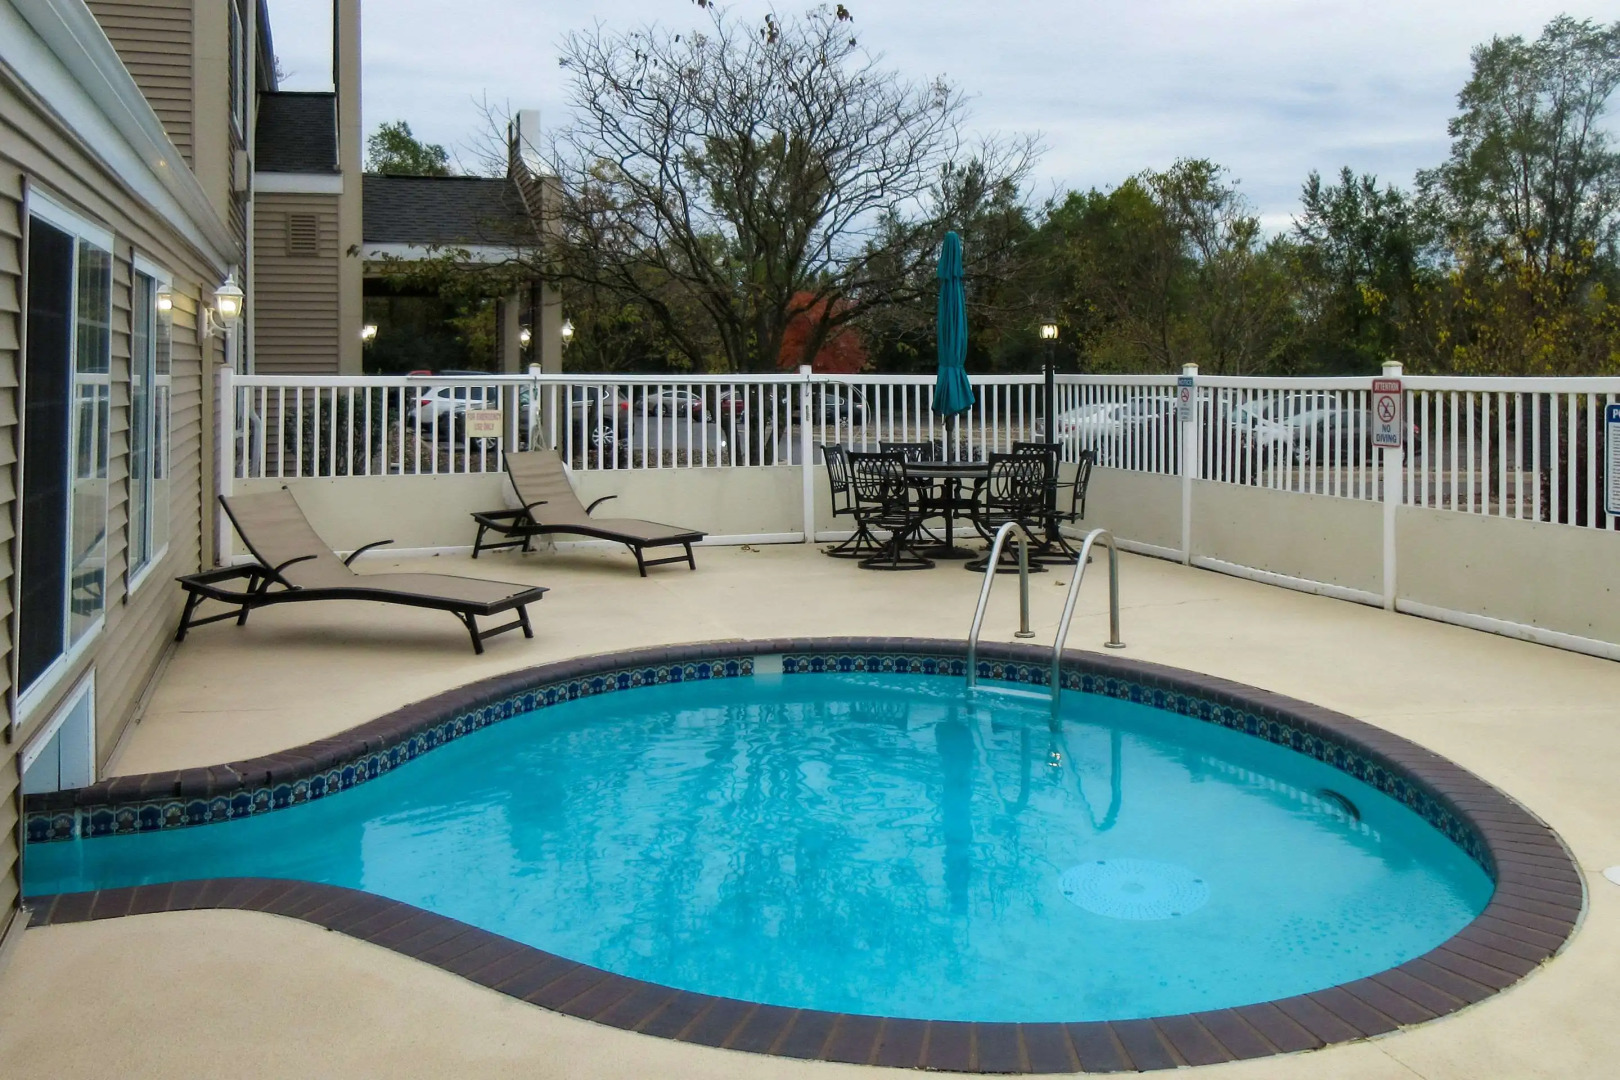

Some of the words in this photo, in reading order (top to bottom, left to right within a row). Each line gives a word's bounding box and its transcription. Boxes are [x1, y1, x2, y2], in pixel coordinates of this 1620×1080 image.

[1375, 382, 1397, 390] ATTENTION
[467, 412, 475, 420] FOR
[476, 412, 501, 421] EMERGENCY
[484, 422, 494, 430] ONLY
[1381, 424, 1391, 433] NO
[1376, 433, 1397, 443] DIVING
